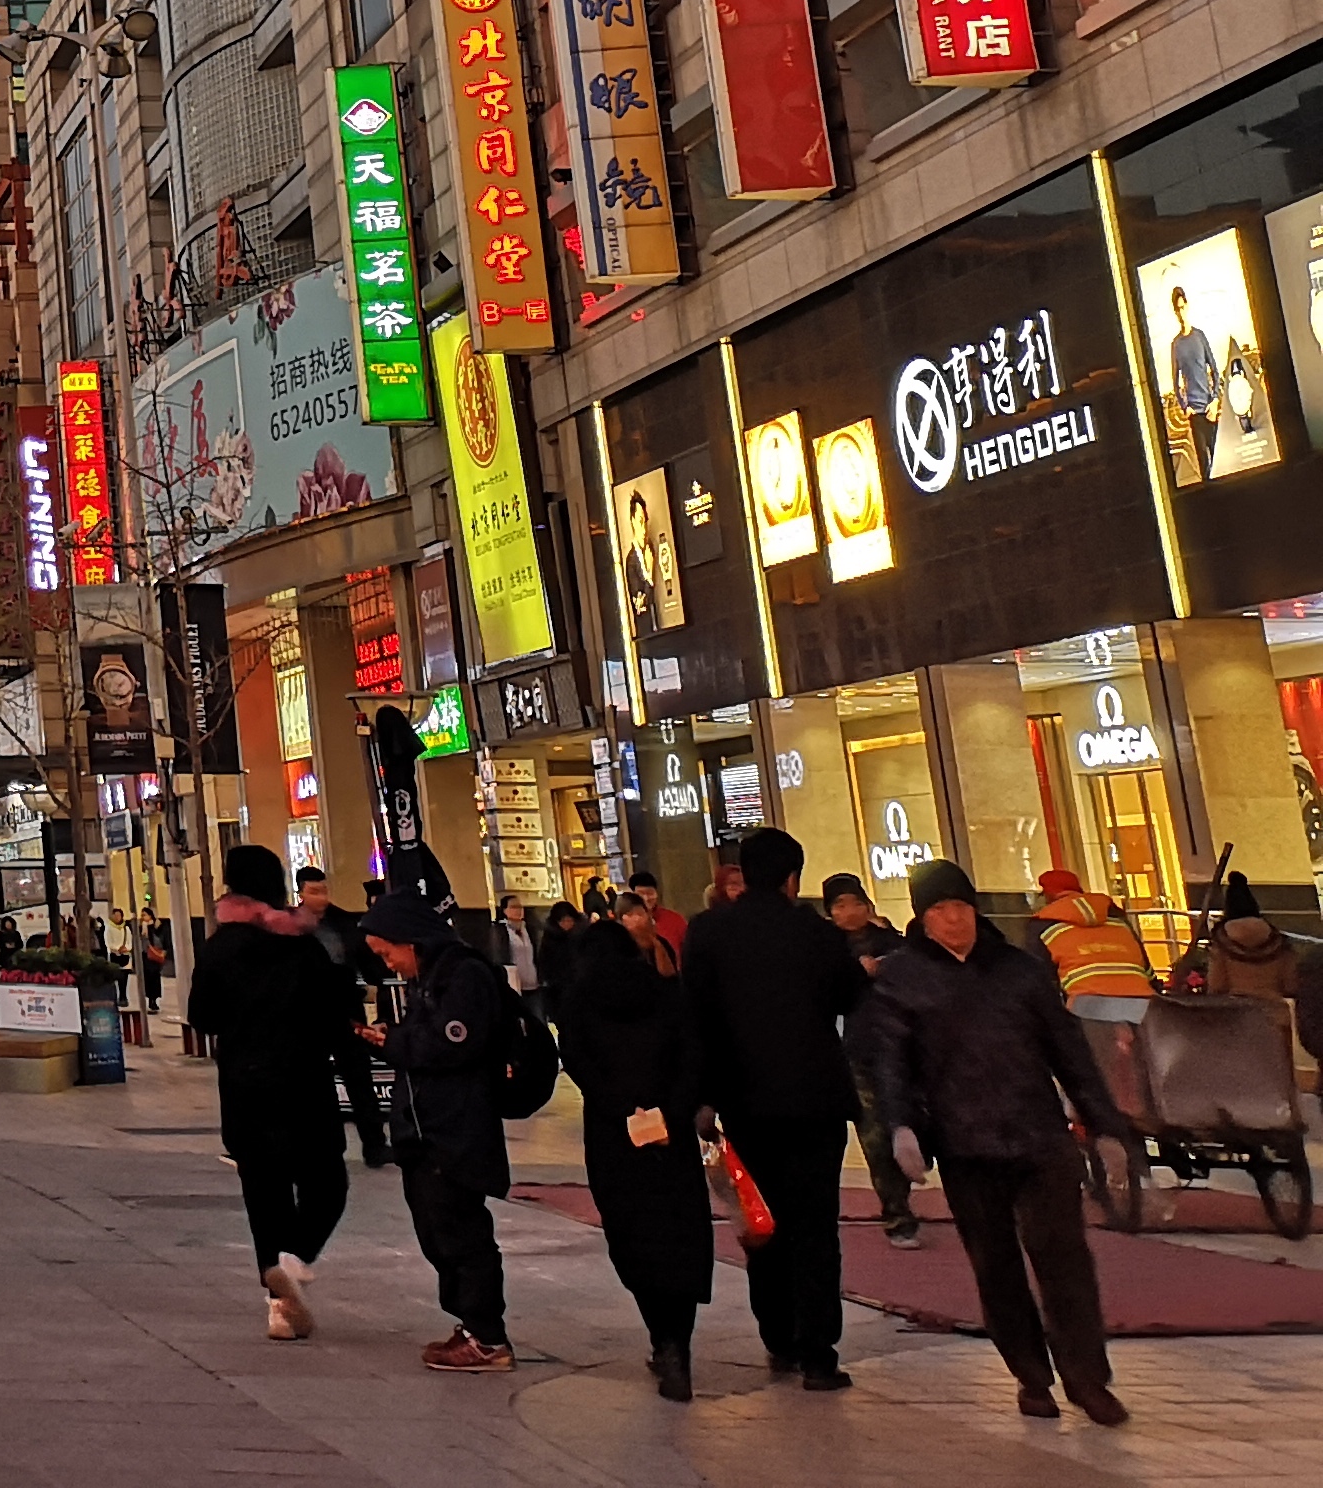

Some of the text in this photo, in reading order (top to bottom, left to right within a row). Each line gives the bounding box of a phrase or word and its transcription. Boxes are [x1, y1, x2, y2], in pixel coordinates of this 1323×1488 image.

[458, 17, 532, 285] 北京同仁堂
[353, 152, 414, 339] 天福茗茶
[606, 216, 623, 273] OPTICAL
[269, 337, 353, 401] 招商热线
[379, 375, 409, 386] TEA
[942, 309, 1061, 428] 亨得利
[270, 383, 359, 442] 65240557
[963, 405, 1097, 482] HENGDELI
[23, 437, 58, 592] LI-NING
[1076, 725, 1162, 768] OMEGA
